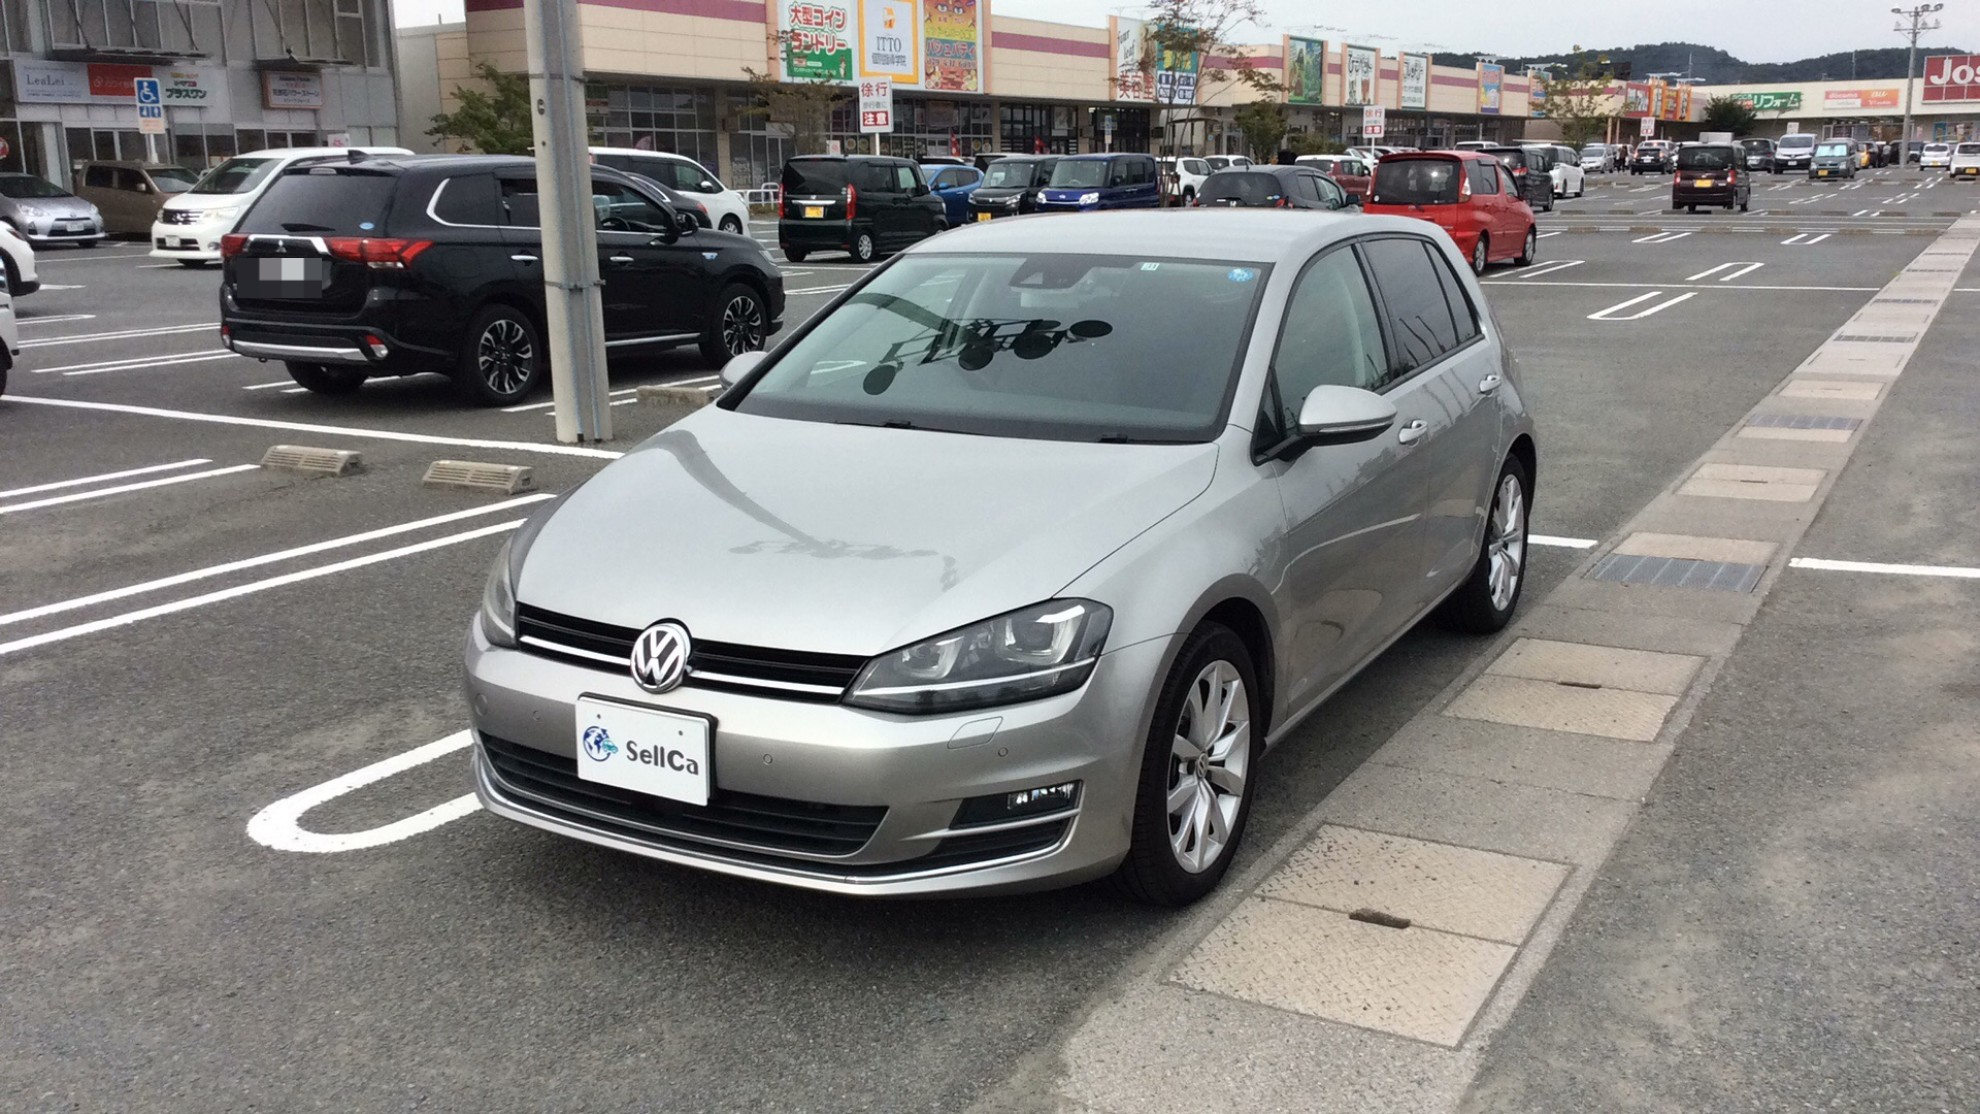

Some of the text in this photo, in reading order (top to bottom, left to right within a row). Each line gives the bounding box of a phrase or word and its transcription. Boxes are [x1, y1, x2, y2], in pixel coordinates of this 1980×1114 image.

[790, 5, 846, 29] 大型コイン
[791, 30, 847, 53] ランドリー
[876, 36, 902, 52] ITTO
[165, 88, 207, 99] プラスワン
[861, 82, 888, 98] 徐行
[1753, 93, 1800, 109] リフォーム
[625, 740, 699, 775] SellCa
